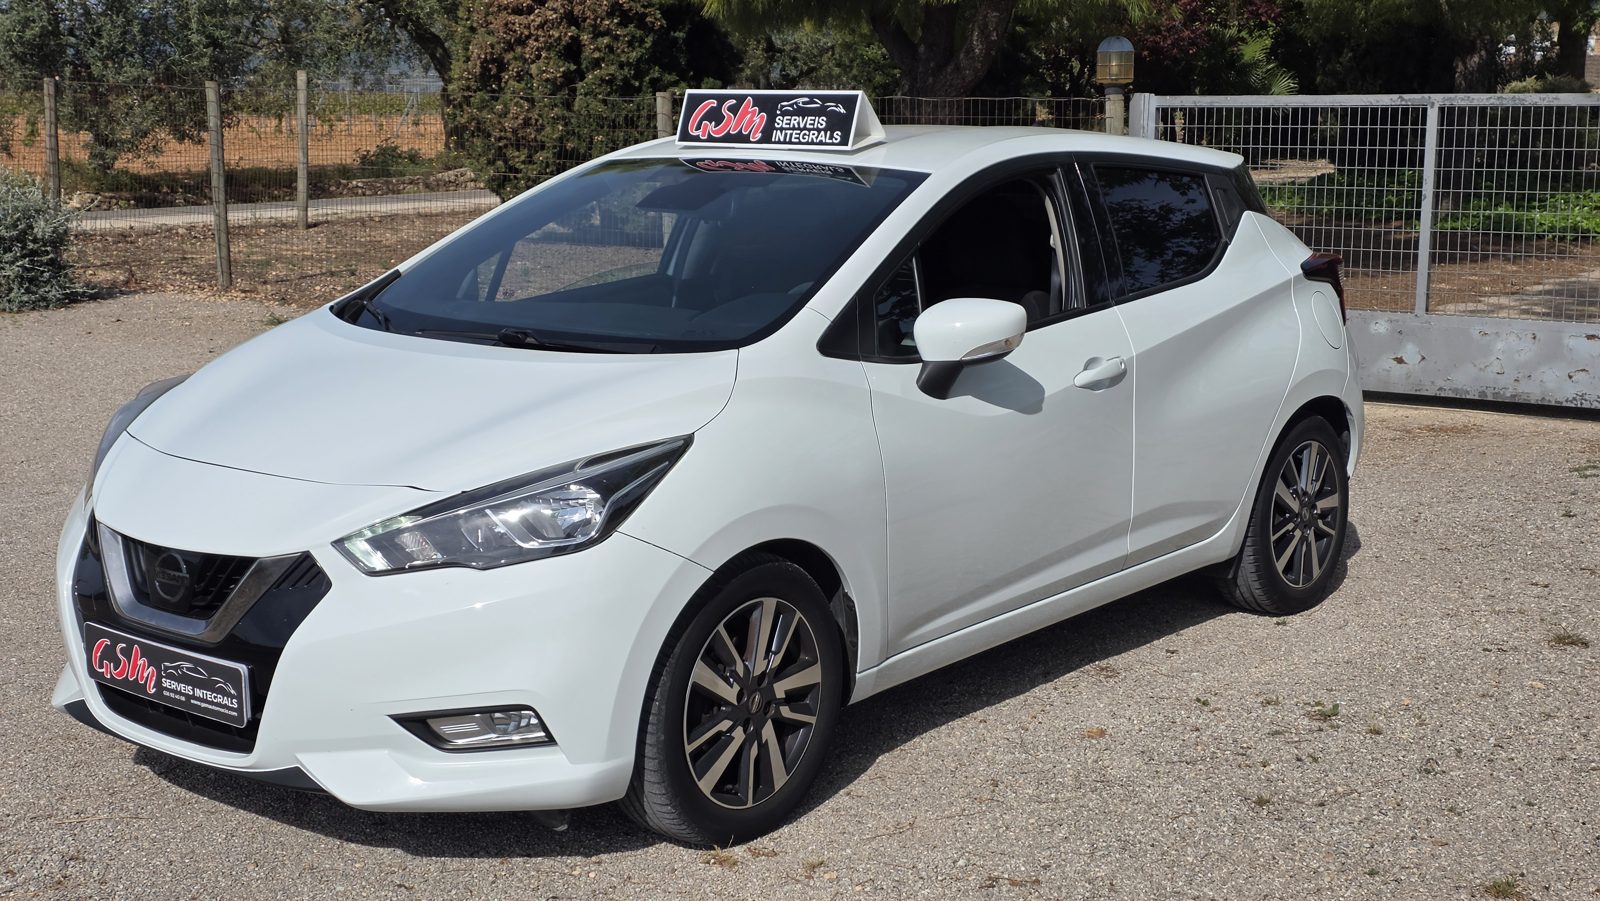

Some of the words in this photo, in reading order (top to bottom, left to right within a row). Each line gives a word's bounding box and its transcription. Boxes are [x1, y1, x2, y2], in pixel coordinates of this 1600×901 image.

[774, 115, 827, 129] SERVEIS
[772, 129, 841, 143] INTEGRALS
[161, 678, 194, 695] SERVEIS
[194, 687, 238, 708] INTEGRALS
